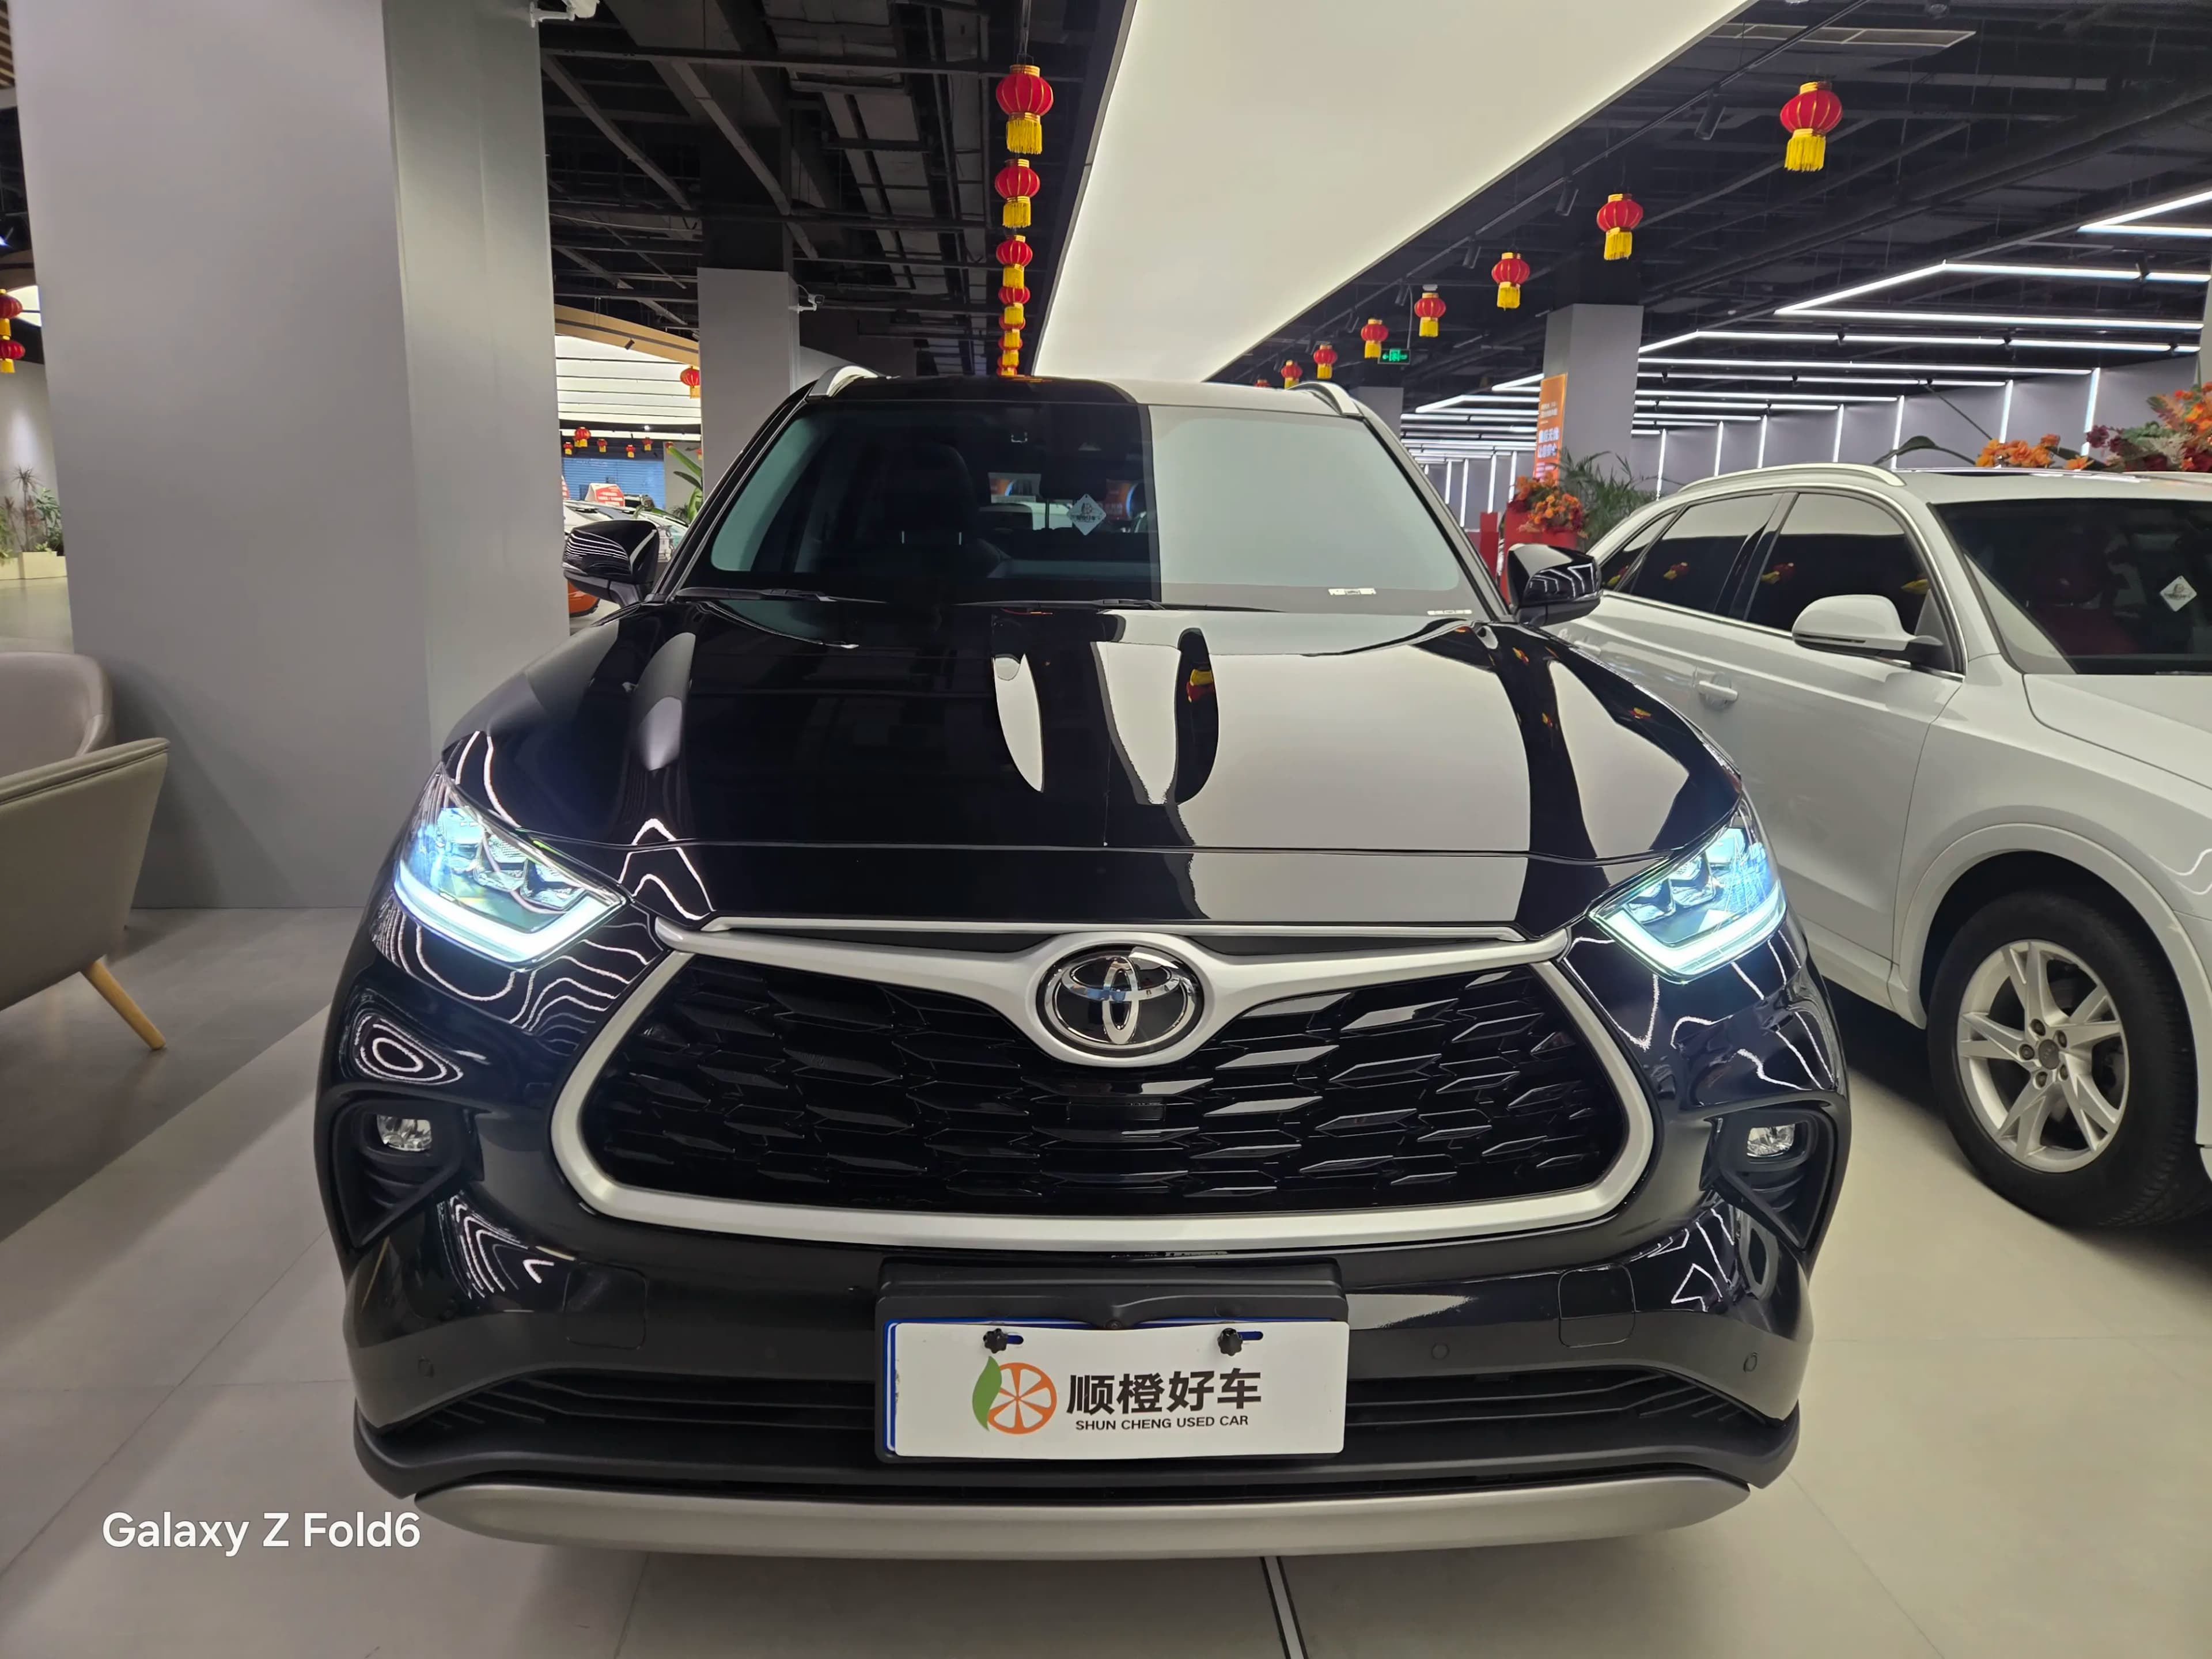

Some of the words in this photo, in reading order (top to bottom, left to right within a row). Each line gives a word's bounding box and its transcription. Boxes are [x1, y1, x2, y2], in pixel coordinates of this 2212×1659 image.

[1066, 1368, 1262, 1415] 顺橙好车
[1075, 1420, 1116, 1430] SHUN
[1121, 1418, 1172, 1430] CHENG
[1176, 1416, 1215, 1428] USED
[1219, 1415, 1249, 1426] CAR
